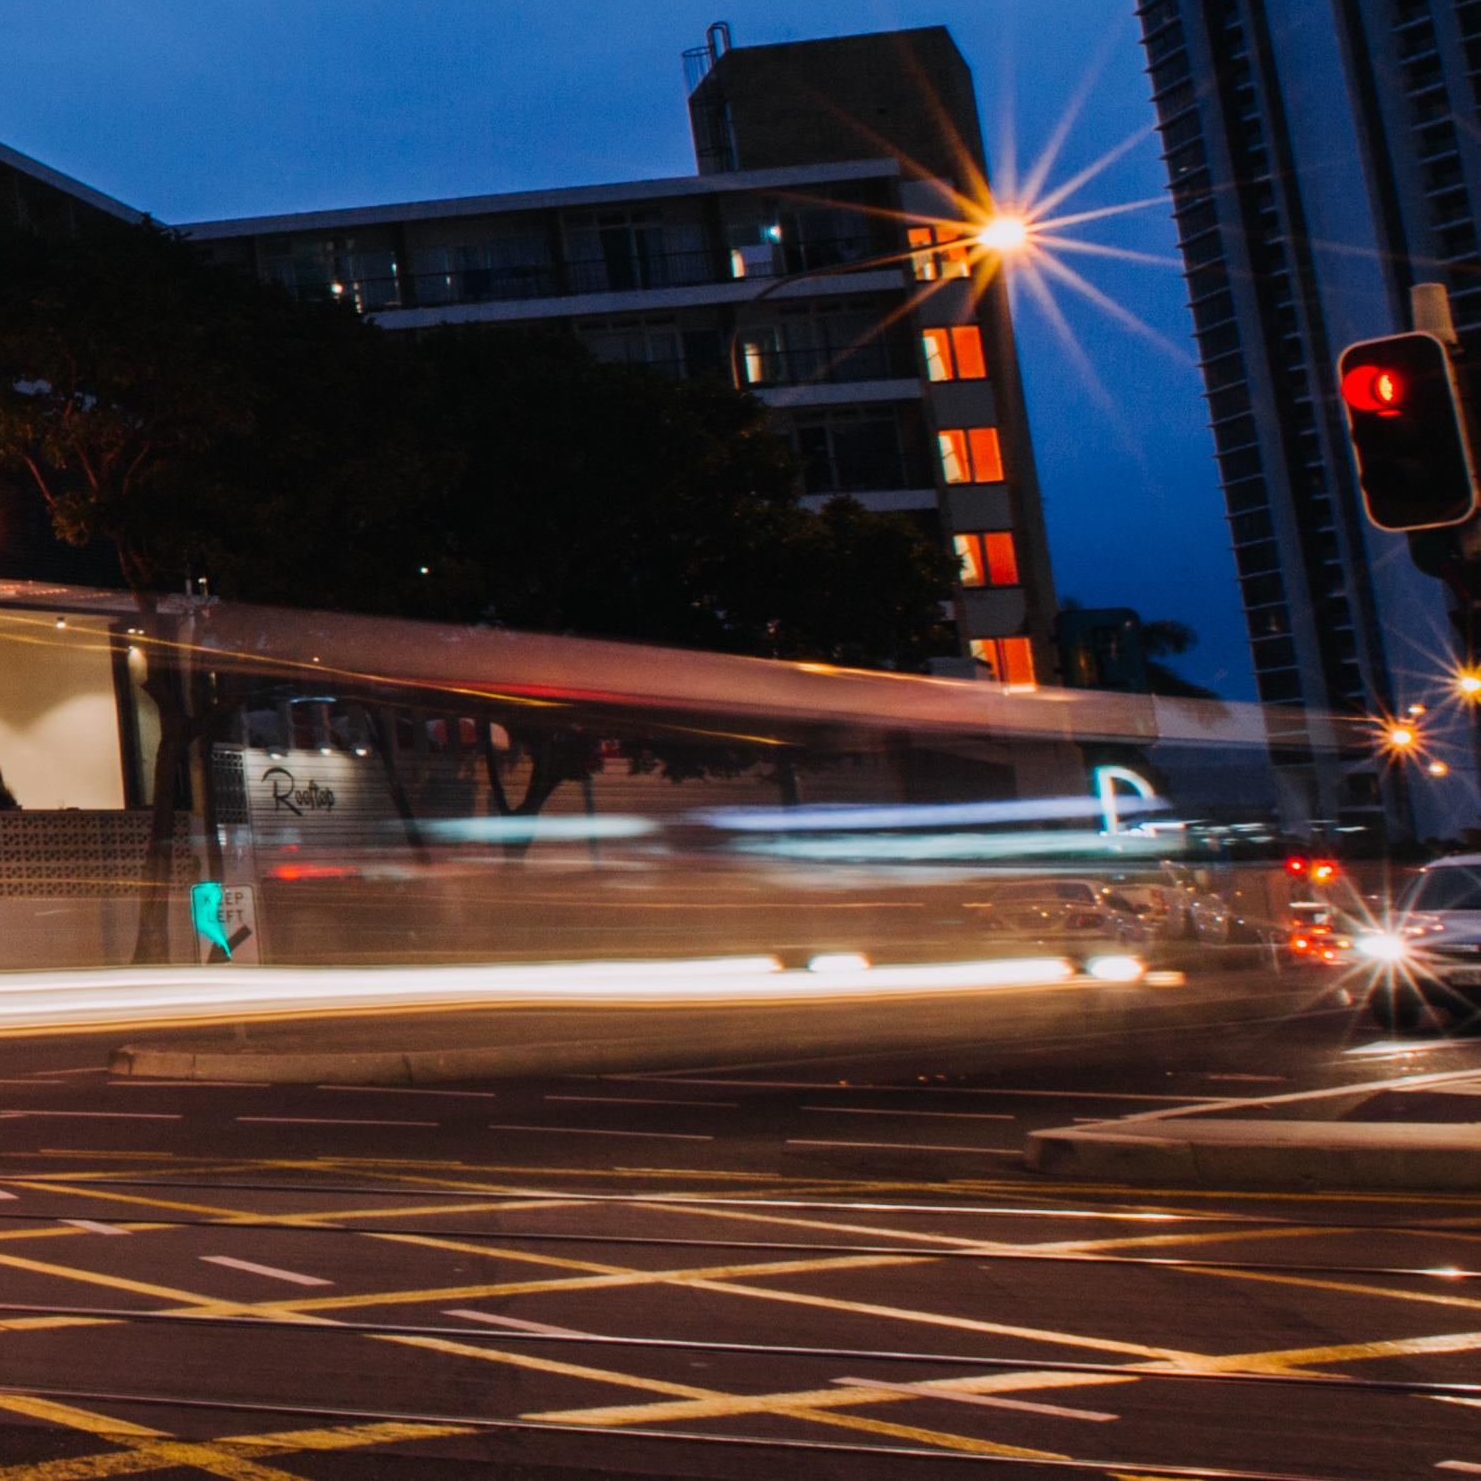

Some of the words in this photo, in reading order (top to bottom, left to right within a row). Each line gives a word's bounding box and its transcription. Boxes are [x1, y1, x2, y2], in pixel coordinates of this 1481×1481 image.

[260, 766, 335, 817] Rooftop
[204, 891, 244, 906] KEP
[207, 909, 244, 924] LEFT
